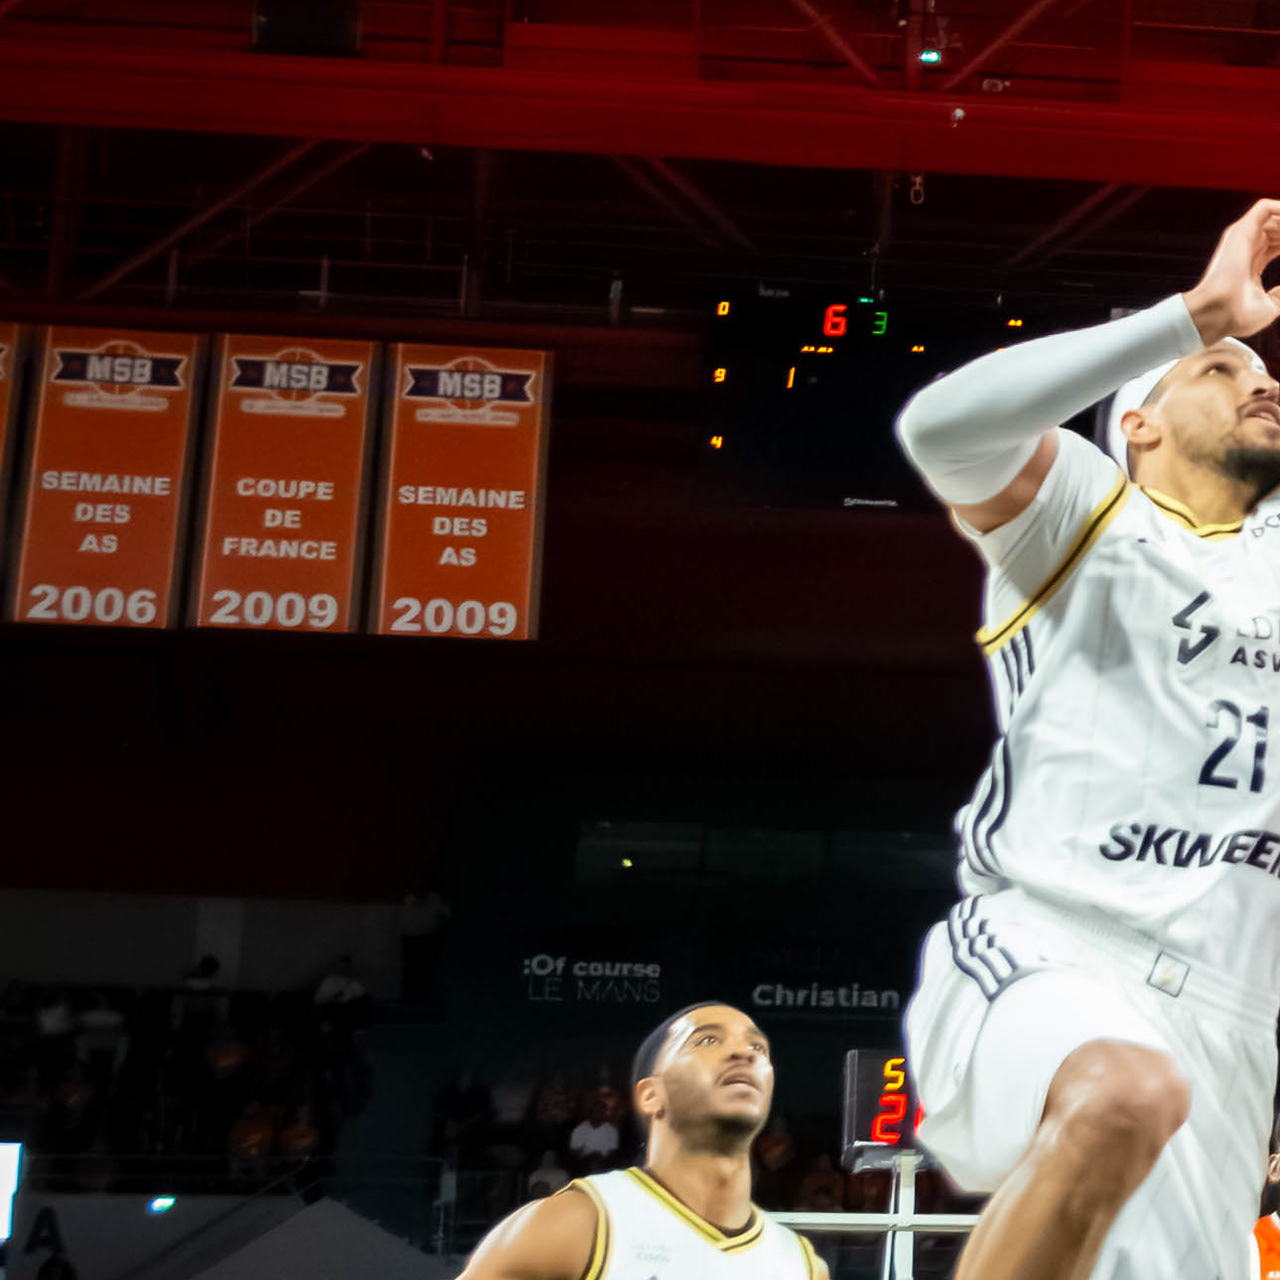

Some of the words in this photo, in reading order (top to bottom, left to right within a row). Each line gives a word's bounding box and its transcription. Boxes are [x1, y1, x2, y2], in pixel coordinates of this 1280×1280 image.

[823, 304, 848, 337] 6
[872, 312, 888, 335] 3
[86, 356, 153, 384] MSB
[264, 363, 329, 391] MSB
[437, 371, 502, 399] MSB
[41, 471, 172, 496] SEMAINE
[236, 477, 335, 501] COUPE
[399, 485, 525, 510] SEMAINE
[74, 502, 131, 524] DES
[264, 508, 301, 528] DE
[432, 516, 488, 538] DES
[79, 534, 119, 554] AS
[222, 537, 337, 561] FRANCE
[438, 547, 477, 567] AS
[27, 584, 157, 624] 2006
[209, 589, 338, 629] 2009
[390, 597, 518, 637] 2009
[1198, 700, 1270, 794] 21
[573, 958, 661, 978] course
[527, 978, 564, 1002] LE
[576, 978, 661, 1003] MANS
[752, 984, 900, 1009] Christian
